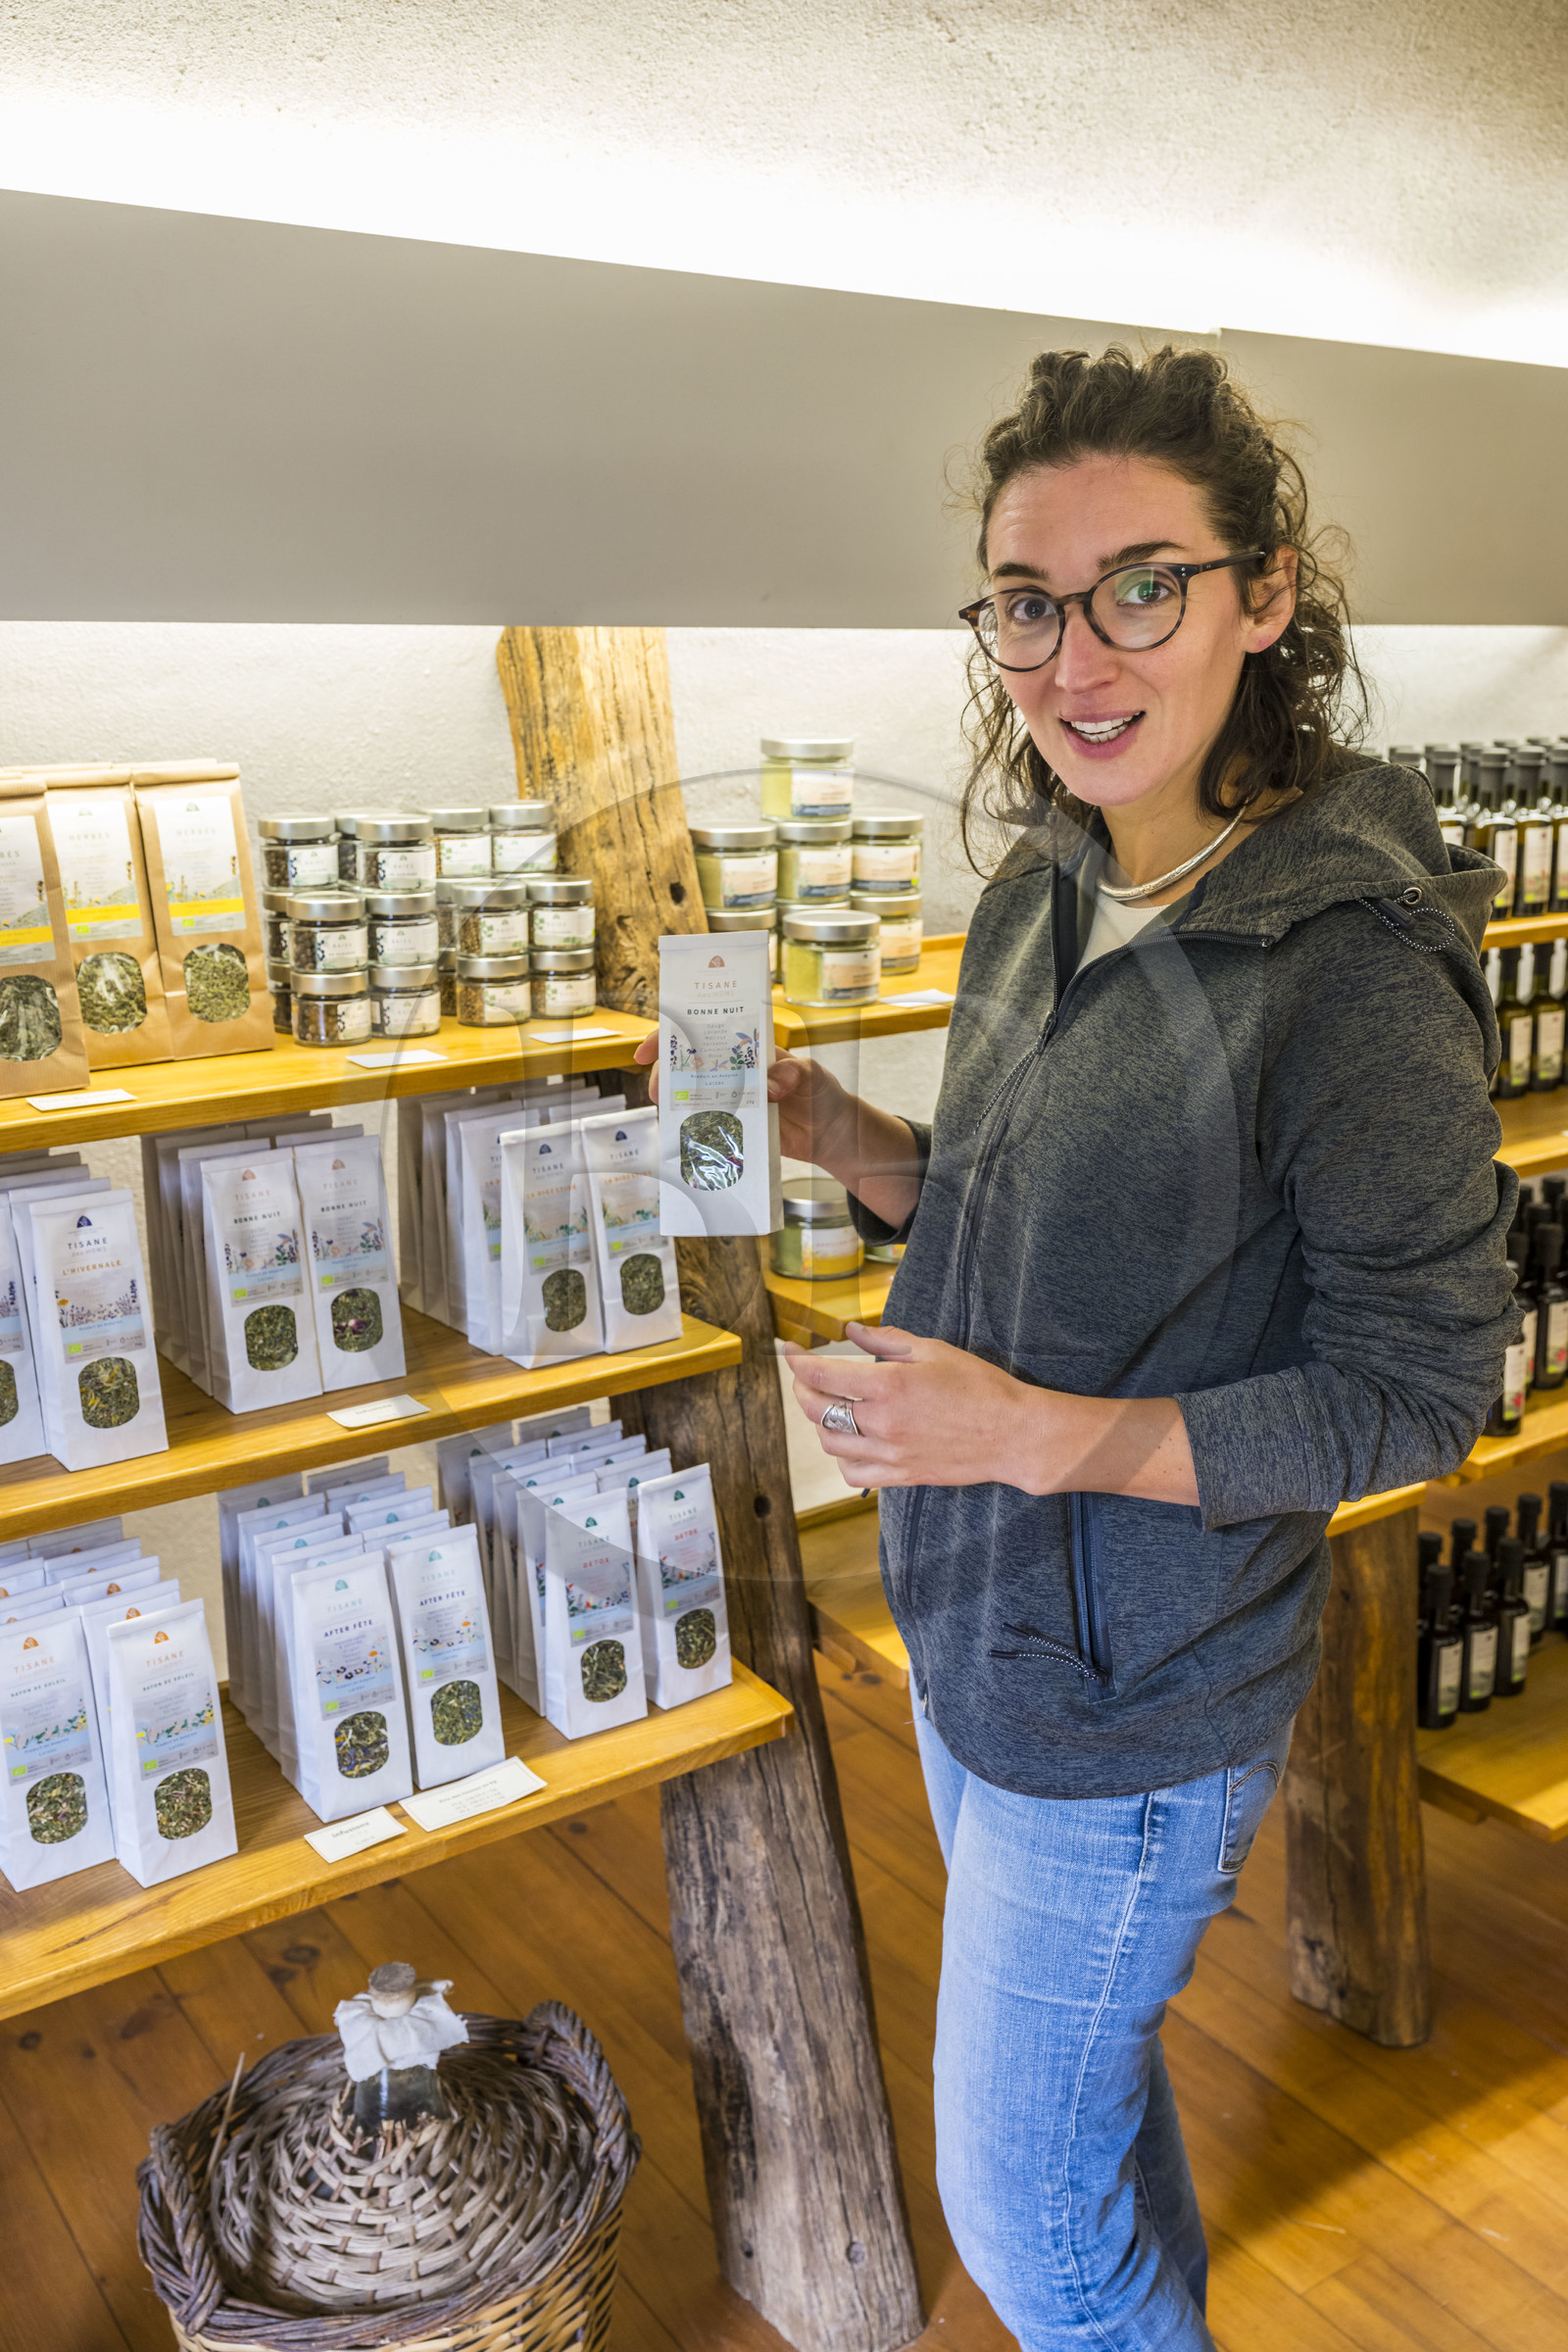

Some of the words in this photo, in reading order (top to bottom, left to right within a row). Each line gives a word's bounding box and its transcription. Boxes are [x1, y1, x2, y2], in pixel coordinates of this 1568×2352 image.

[533, 1162, 564, 1174] TISANE
[323, 1179, 358, 1190] TISANE
[235, 1190, 270, 1201] TISANE
[321, 1203, 345, 1212] BONNE
[234, 1215, 258, 1224] BONNE
[68, 1237, 108, 1250] TISANE
[63, 1259, 121, 1276] L'HIVERNALE
[669, 1506, 697, 1521] TISANE
[579, 1535, 610, 1547] TISANE
[675, 1529, 698, 1542] DETOX
[583, 1557, 610, 1569] DETOX
[421, 1569, 455, 1583] TISANE
[419, 1595, 443, 1606] AFTER
[447, 1590, 466, 1599] FÊTE
[327, 1598, 363, 1613] TISANE
[324, 1626, 350, 1638] AFTER
[354, 1619, 372, 1630] FÊTE
[14, 1656, 55, 1673] TISANE
[146, 1650, 184, 1667] TISANE
